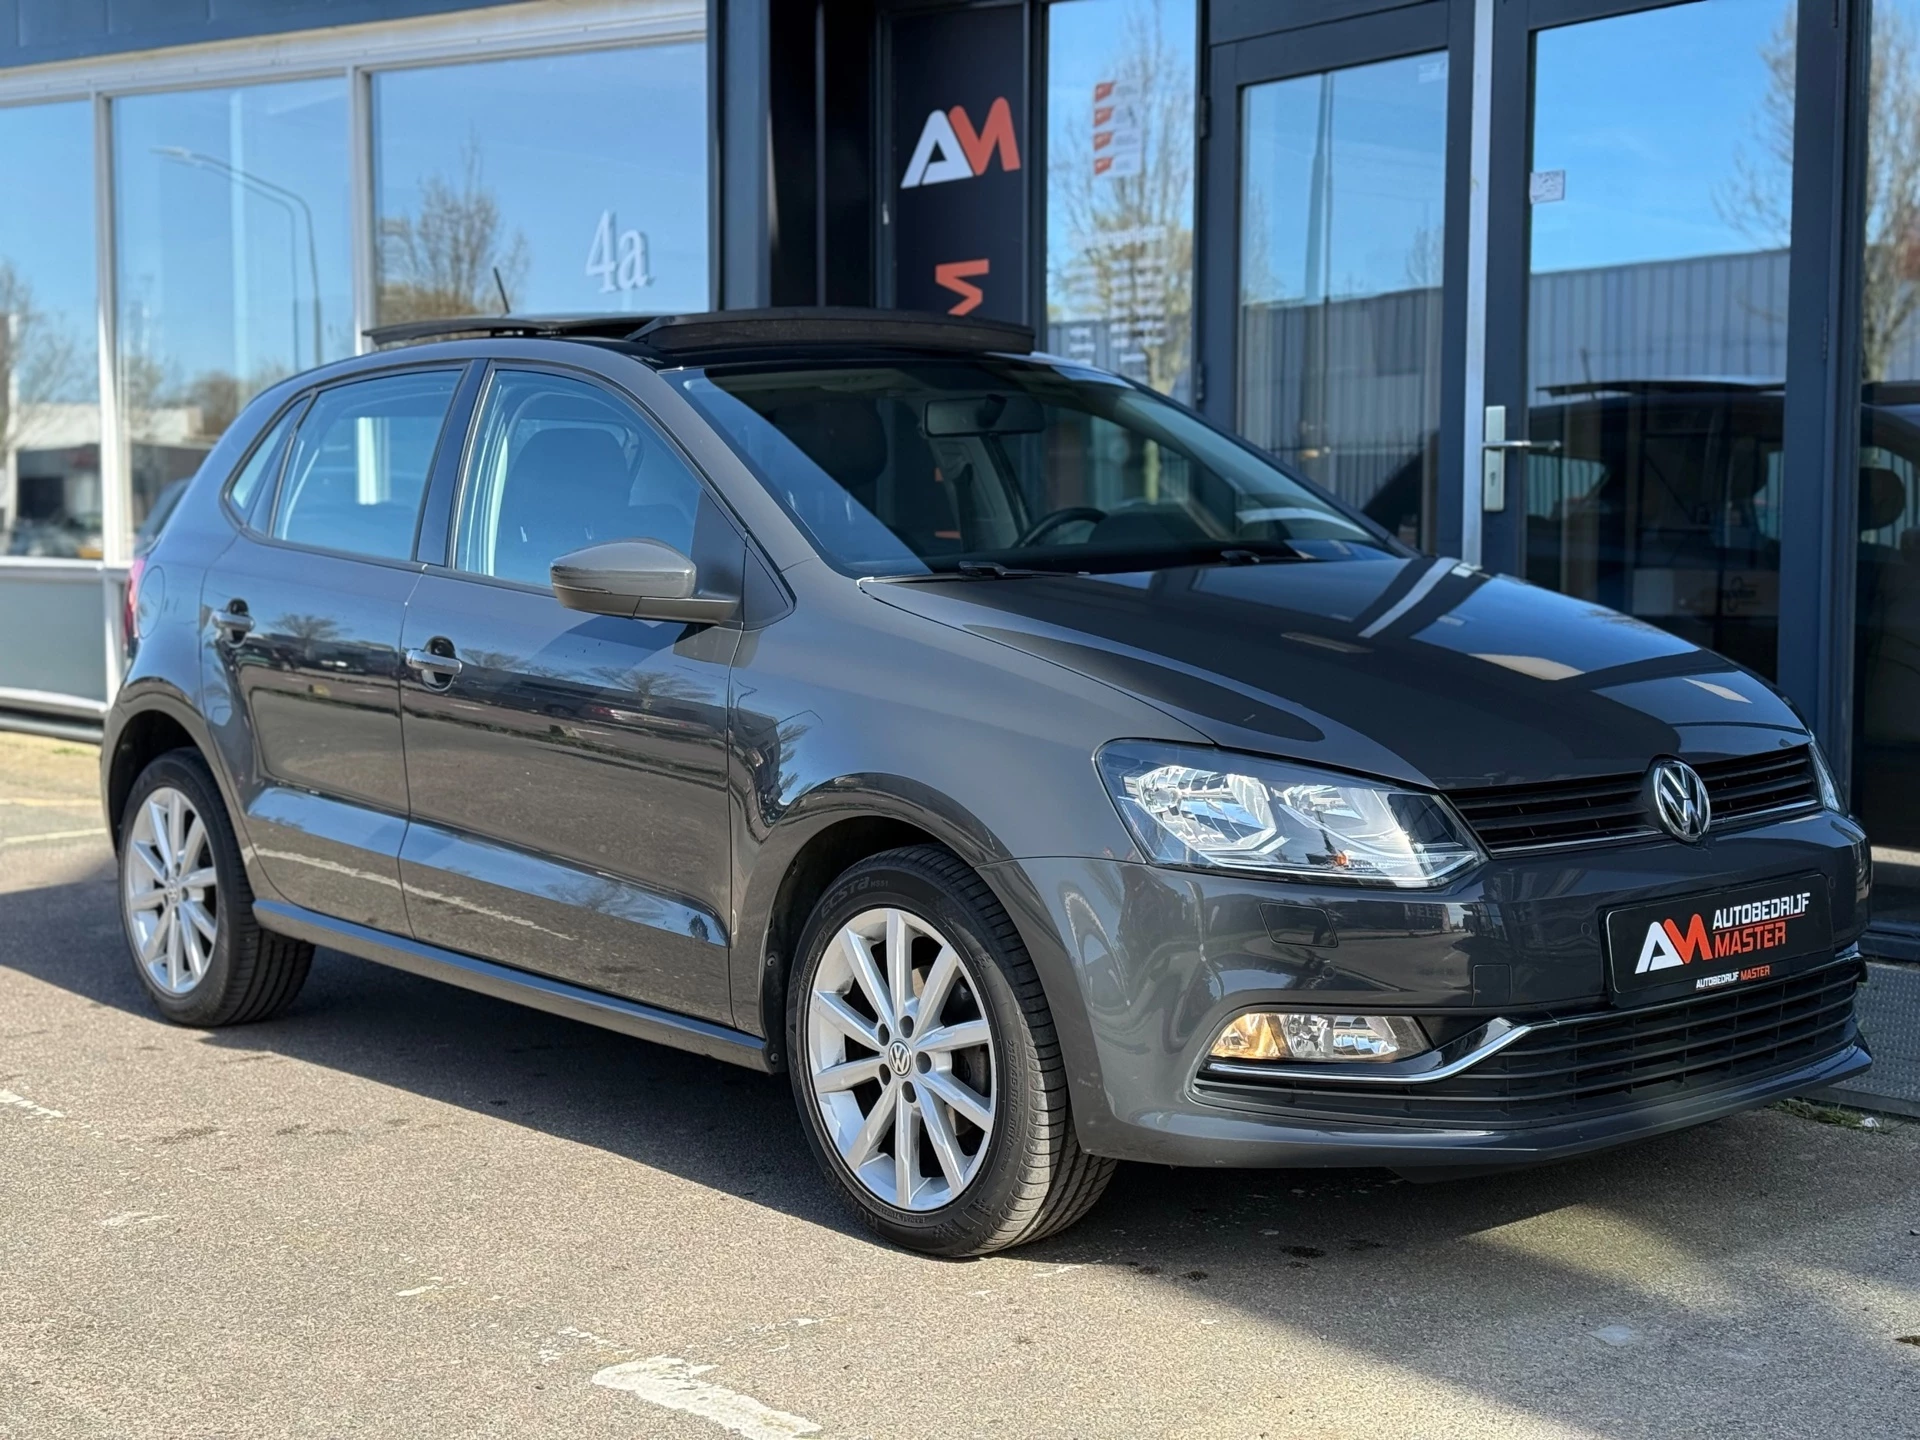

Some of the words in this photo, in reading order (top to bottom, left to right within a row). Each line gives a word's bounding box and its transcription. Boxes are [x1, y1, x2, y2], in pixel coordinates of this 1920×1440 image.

[900, 97, 1021, 189] AM
[585, 208, 653, 294] 4a
[1713, 892, 1811, 930] AUTOBEDRIJF
[1634, 913, 1714, 974] AM
[1714, 921, 1786, 959] MASTER
[1695, 971, 1740, 989] AUTOBEDRIJF
[1740, 965, 1770, 981] MASTER
